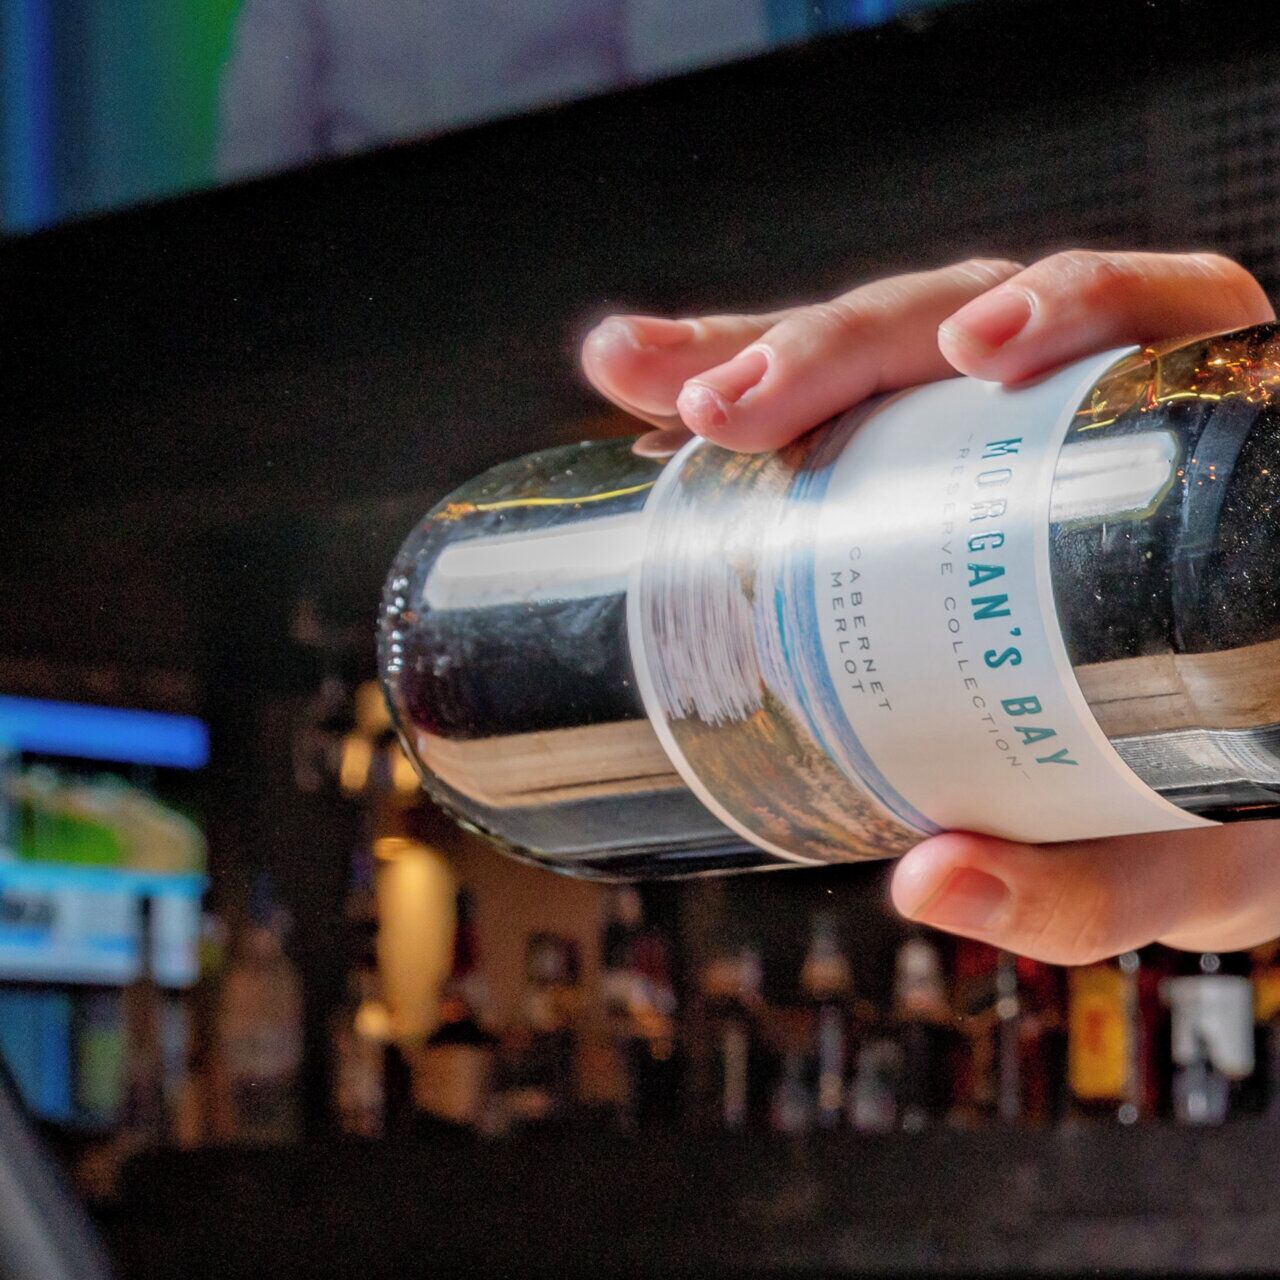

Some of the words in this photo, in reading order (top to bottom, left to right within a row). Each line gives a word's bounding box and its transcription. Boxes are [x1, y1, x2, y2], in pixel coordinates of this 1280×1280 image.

[831, 572, 865, 693] MERLOT
[850, 547, 892, 711] CABERNET
[967, 437, 1023, 669] MORGAN'S
[1000, 696, 1079, 766] BAY
